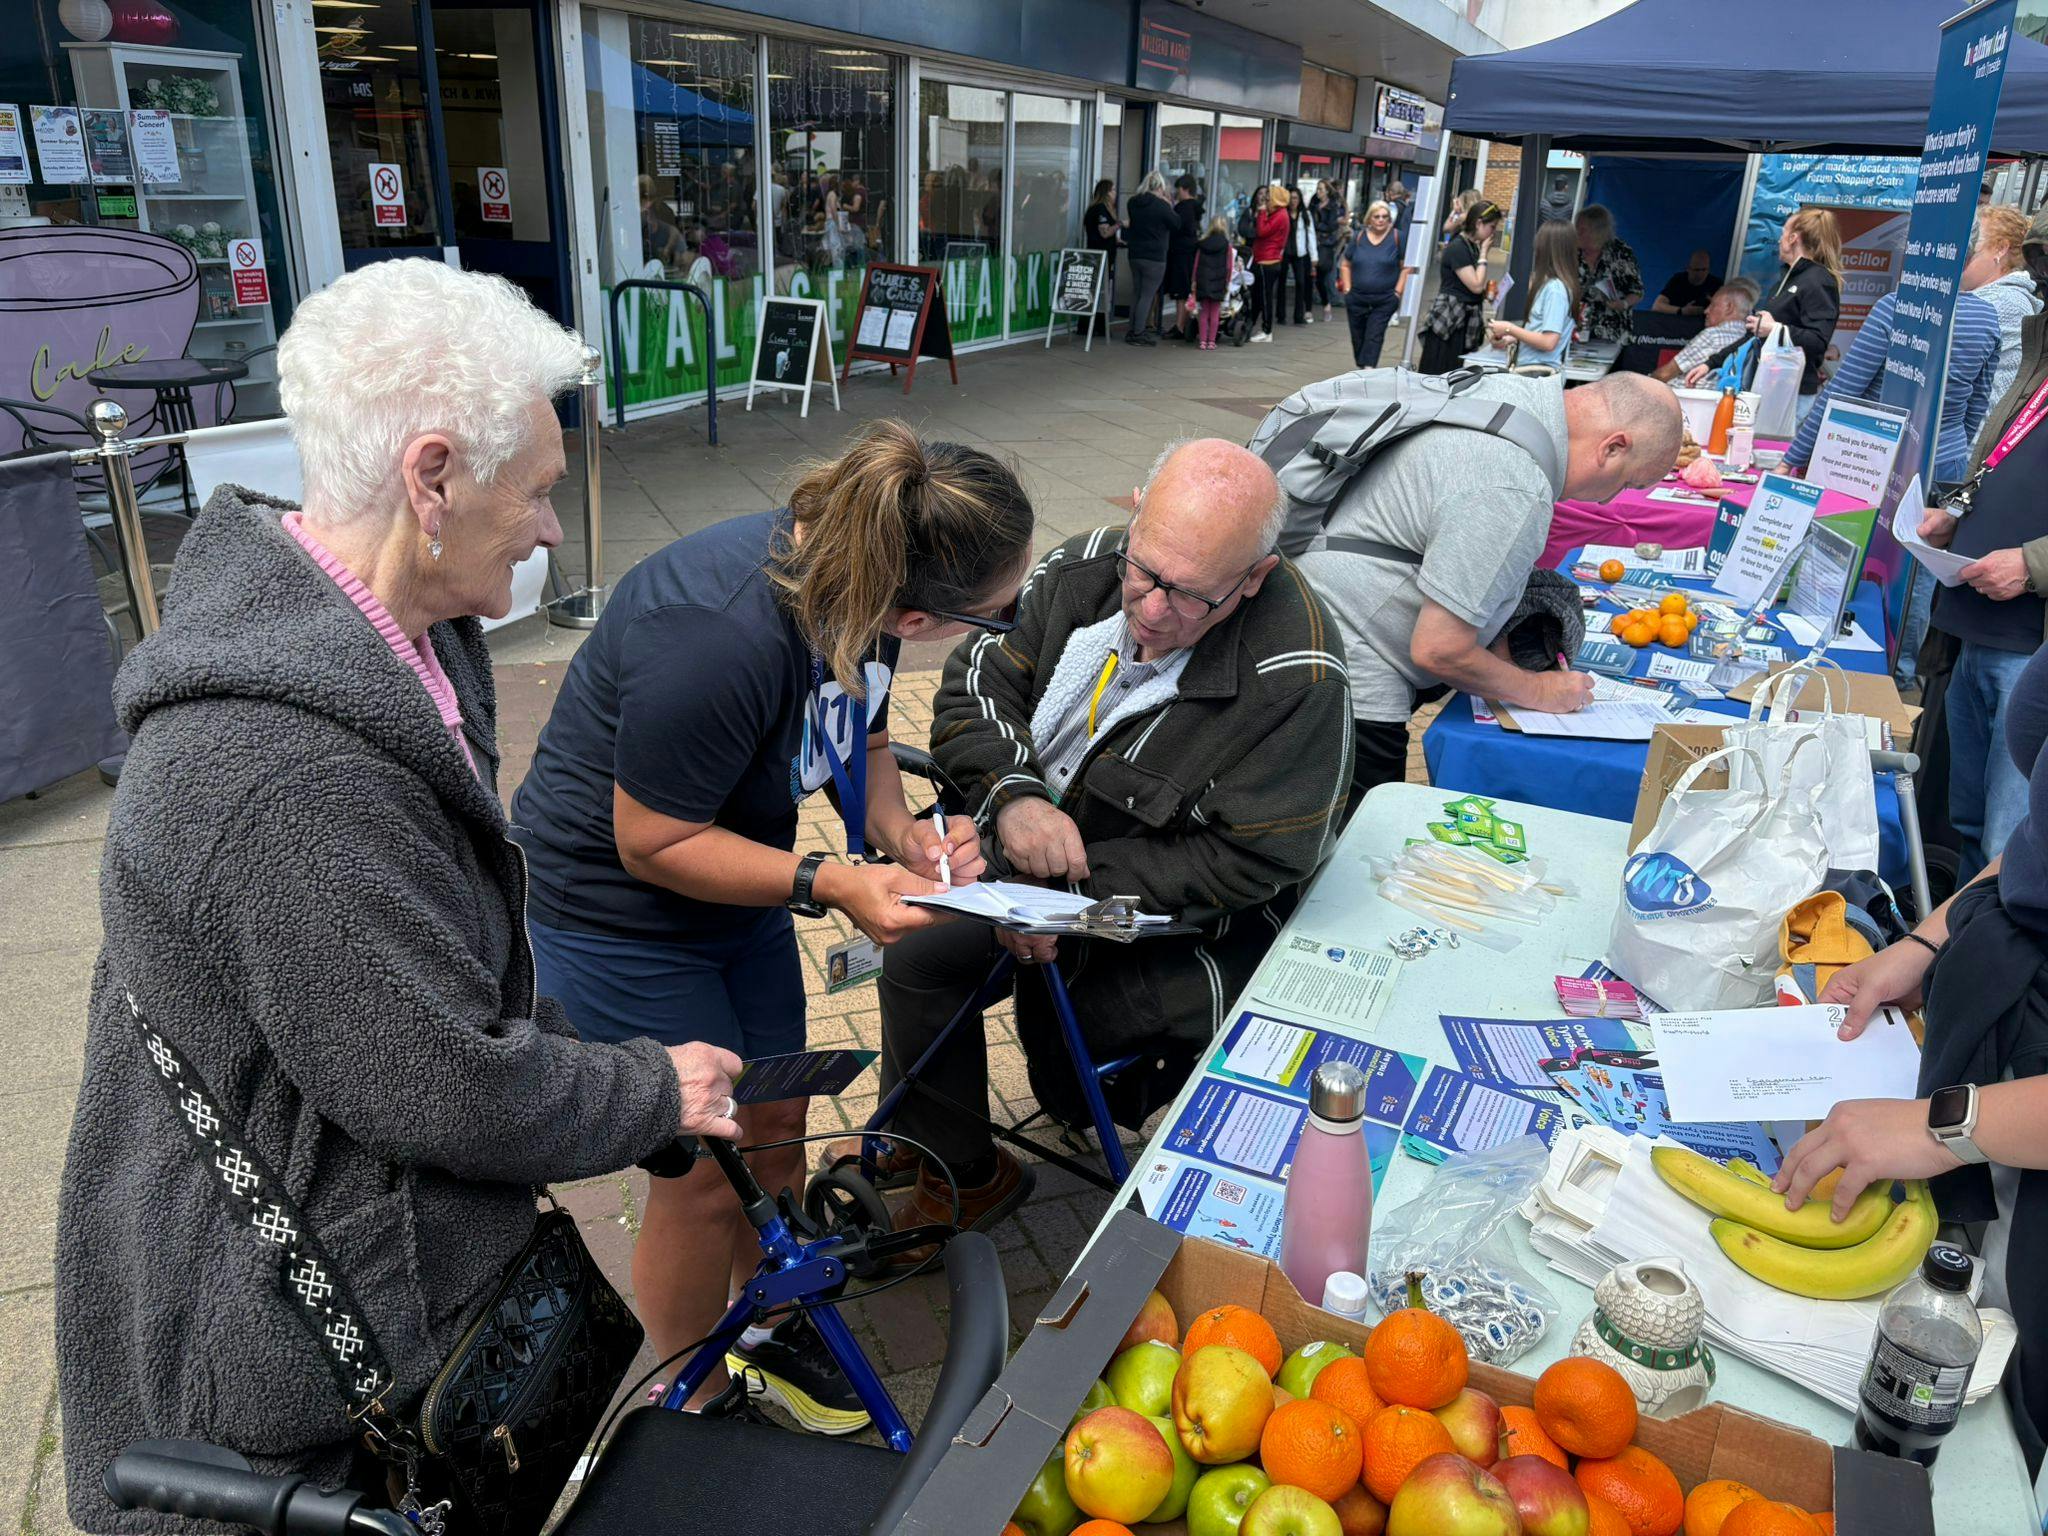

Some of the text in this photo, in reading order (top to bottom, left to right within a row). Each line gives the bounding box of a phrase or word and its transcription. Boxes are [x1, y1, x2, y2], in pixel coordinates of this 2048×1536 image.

[1783, 162, 1791, 171] to
[1826, 163, 1858, 175] market,
[1859, 163, 1890, 174] located
[1806, 172, 1905, 187] Forum Shopping Centre
[1862, 195, 1876, 205] VAT
[1841, 251, 1888, 267] ncillor
[886, 286, 925, 304] CAKES
[31, 326, 152, 402] Cafe
[1758, 514, 1794, 531] Complete and
[1776, 531, 1791, 542] short
[1667, 897, 1719, 918] OPPORTUNITIES
[1827, 1007, 1842, 1024] 2
[1543, 1026, 1561, 1048] Voice
[1556, 1024, 1578, 1050] Tynes
[1573, 1024, 1589, 1039] Our
[1535, 1108, 1554, 1130] Voice
[1261, 1233, 1277, 1255] Tynesid
